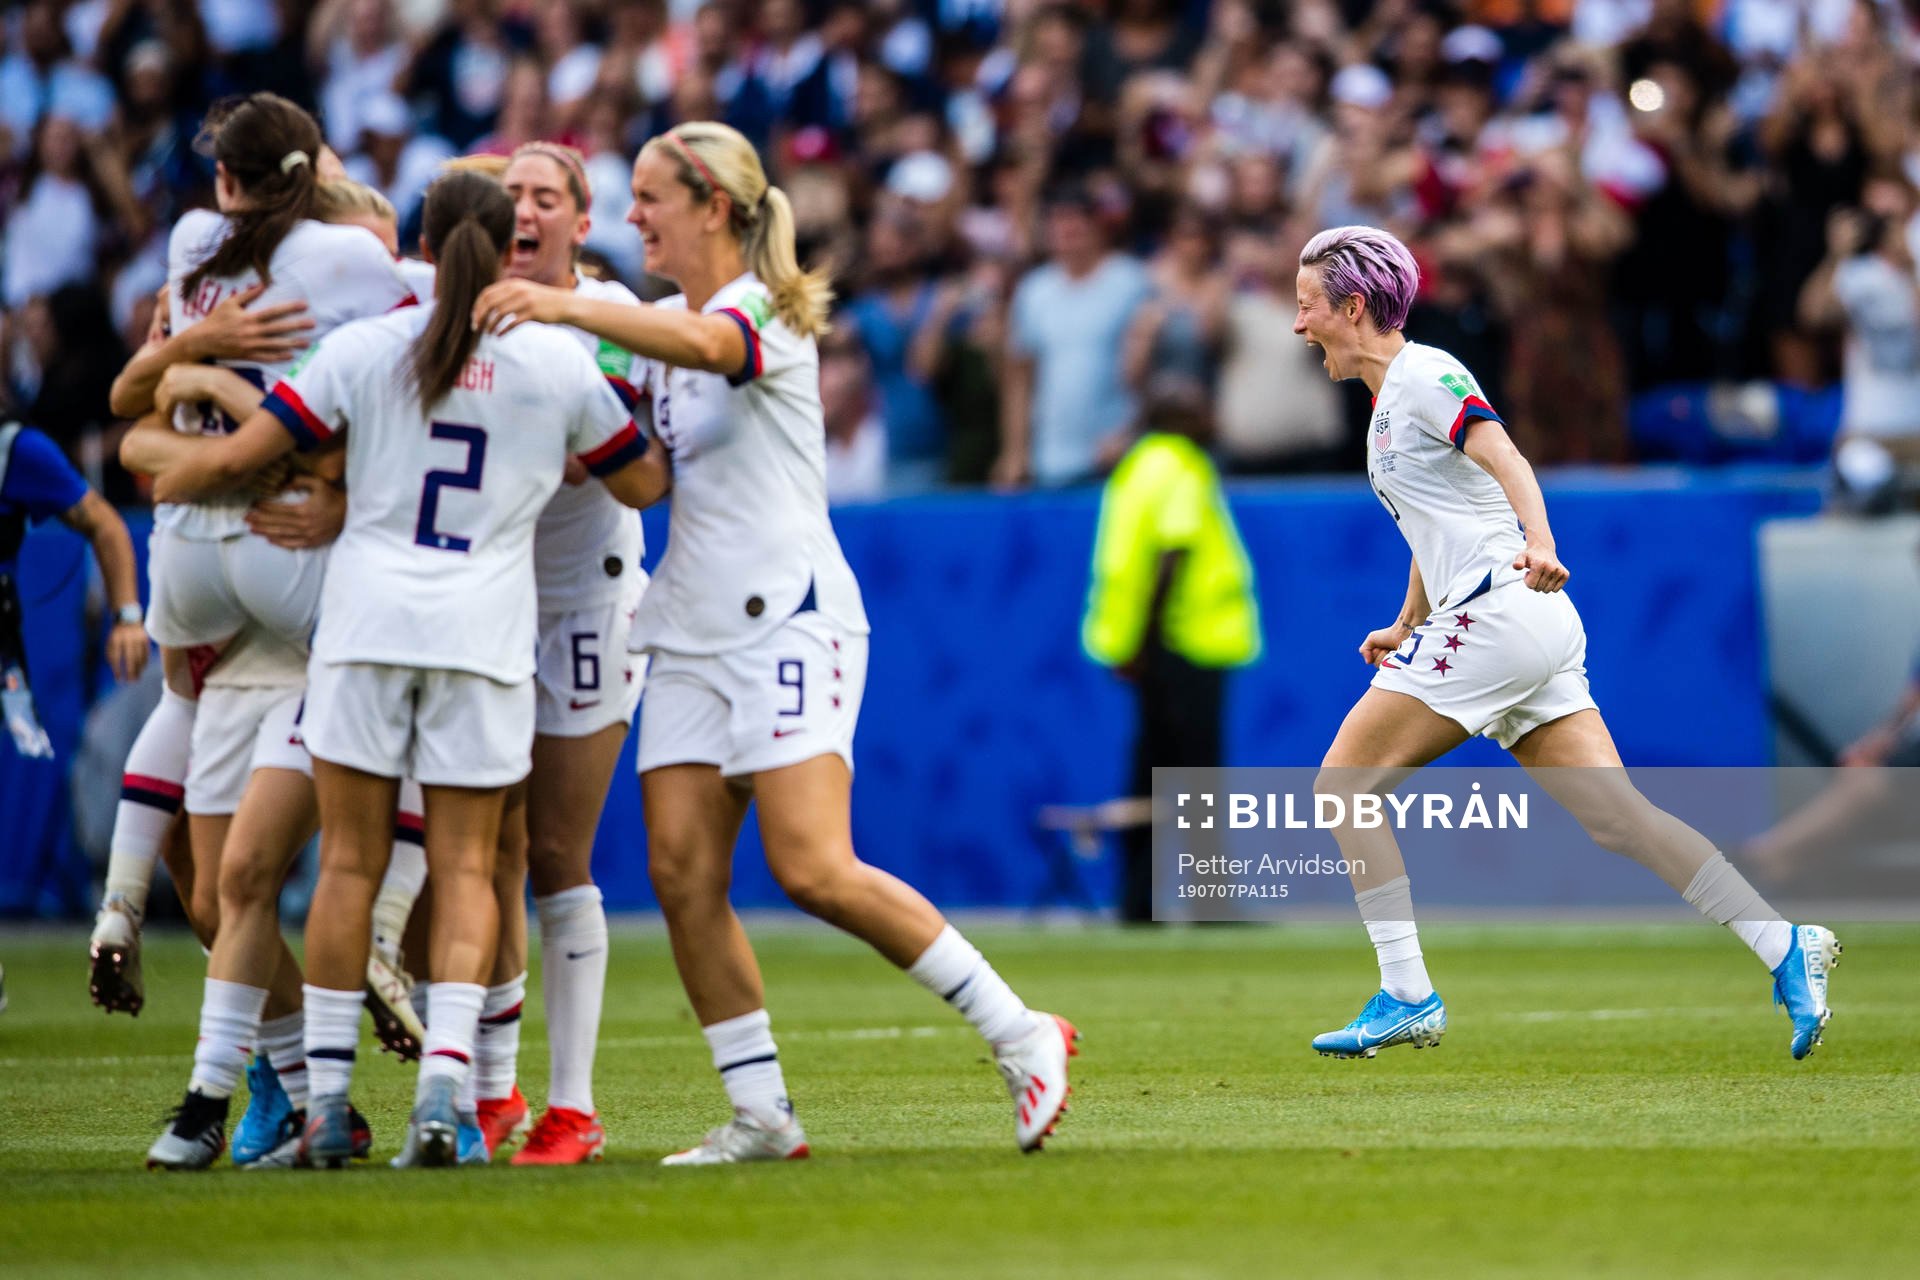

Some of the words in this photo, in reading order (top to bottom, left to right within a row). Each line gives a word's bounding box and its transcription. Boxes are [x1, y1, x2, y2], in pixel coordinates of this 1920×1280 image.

[414, 420, 488, 553] 2
[571, 633, 600, 691] 6
[778, 660, 804, 716] 9
